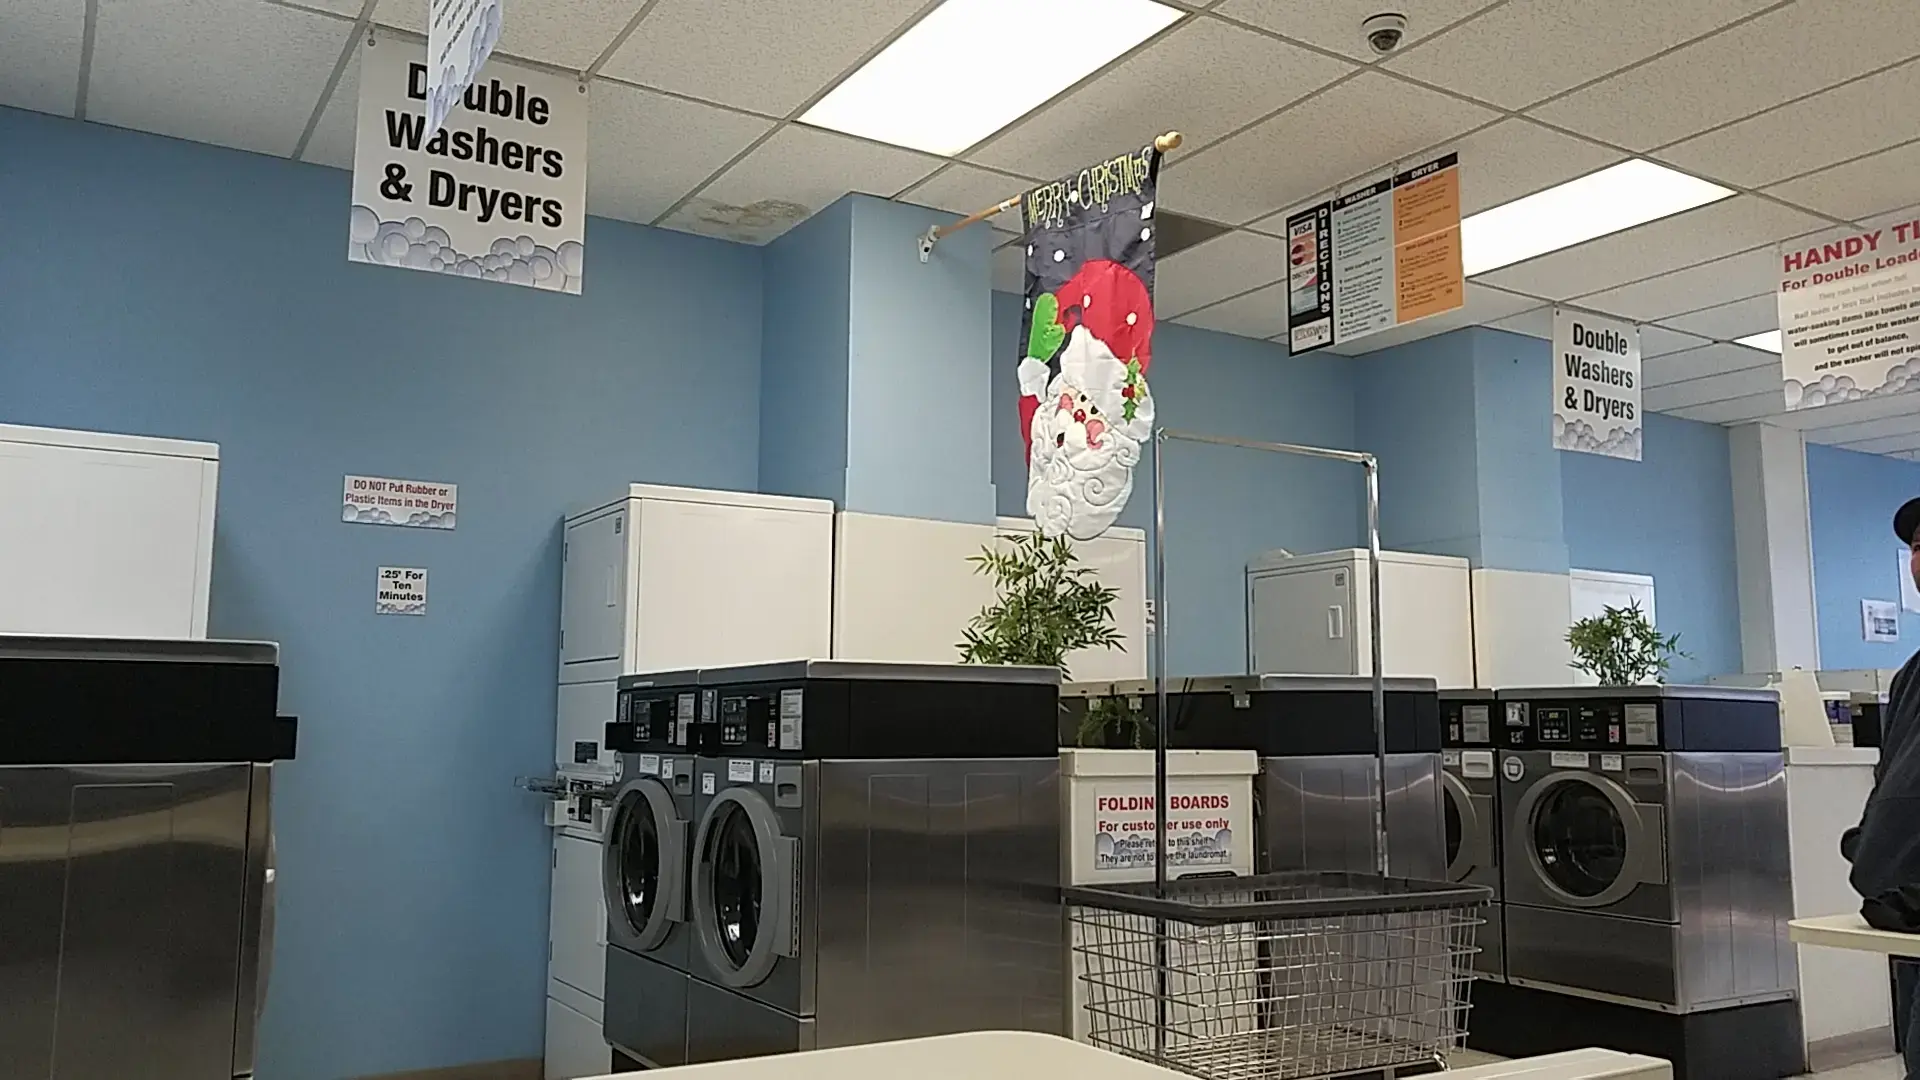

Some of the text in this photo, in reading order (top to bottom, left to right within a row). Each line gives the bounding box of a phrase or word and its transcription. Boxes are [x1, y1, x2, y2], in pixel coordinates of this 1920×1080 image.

[408, 62, 550, 125] Duble
[385, 110, 564, 178] Washers
[1411, 162, 1439, 178] DRYER
[380, 163, 563, 228] & Dryers
[1027, 180, 1072, 229] MERRY
[1293, 222, 1312, 236] VISA
[1783, 230, 1882, 273] HANDY
[1782, 248, 1920, 293] For Double Load
[1787, 319, 1840, 335] water-soaking
[1842, 314, 1862, 324] items
[1865, 310, 1880, 318] like
[1881, 303, 1907, 316] towels
[1573, 322, 1628, 356] Double
[1794, 316, 1920, 348] will sometimes cause the washer
[1837, 344, 1850, 353] get
[1851, 340, 1864, 350] out
[1866, 338, 1874, 347] of
[1814, 362, 1828, 371] and
[1830, 360, 1842, 368] the
[1844, 354, 1872, 365] washer
[1874, 350, 1888, 358] will
[1890, 346, 1904, 356] not
[1564, 353, 1634, 389] Washers
[1564, 386, 1634, 420] & Dryers
[354, 480, 448, 496] DO NOT Put Rubber or
[345, 493, 454, 512] Plastic Items in the Dryer
[392, 580, 412, 590] Ten
[405, 570, 424, 580] For
[379, 591, 424, 601] Minutes
[1098, 796, 1230, 811] FOLDIN BOARDS
[1099, 818, 1230, 832] For custoer use only
[1120, 839, 1144, 848] Please
[1168, 838, 1176, 846] to
[1177, 838, 1190, 846] this
[1192, 836, 1208, 846] shelf
[1101, 854, 1118, 864] They
[1120, 854, 1132, 862] are
[1134, 853, 1144, 862] not
[1146, 853, 1154, 861] to
[1176, 852, 1186, 860] the
